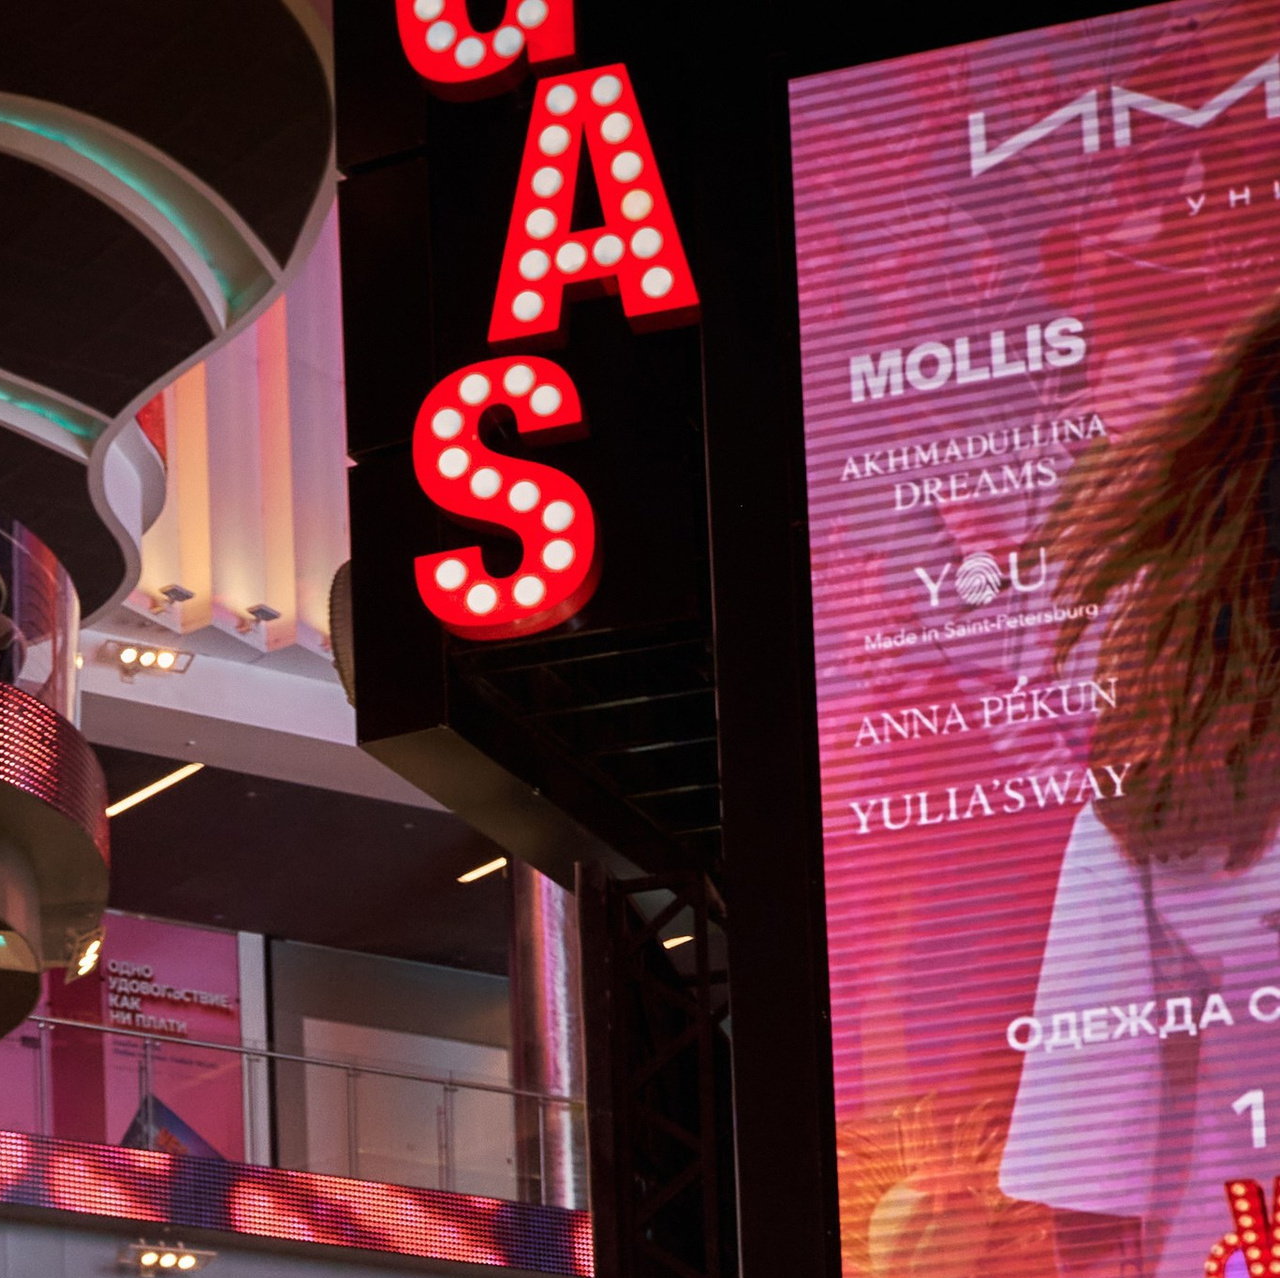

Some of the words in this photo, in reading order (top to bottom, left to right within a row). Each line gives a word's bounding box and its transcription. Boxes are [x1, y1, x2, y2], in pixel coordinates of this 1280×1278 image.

[1185, 180, 1280, 216] УН
[850, 317, 1088, 403] MOLLIS
[840, 413, 1108, 482] AKHMADULLINA
[894, 457, 1058, 511] DREAMS
[914, 546, 1047, 608] YOU
[864, 627, 918, 652] Made
[921, 625, 940, 643] in
[943, 602, 1099, 639] Saint-Petersburg
[854, 702, 970, 749] ANNA
[848, 762, 1132, 835] YULIA'SWAY
[1006, 993, 1235, 1053] ОДЕЖДА
